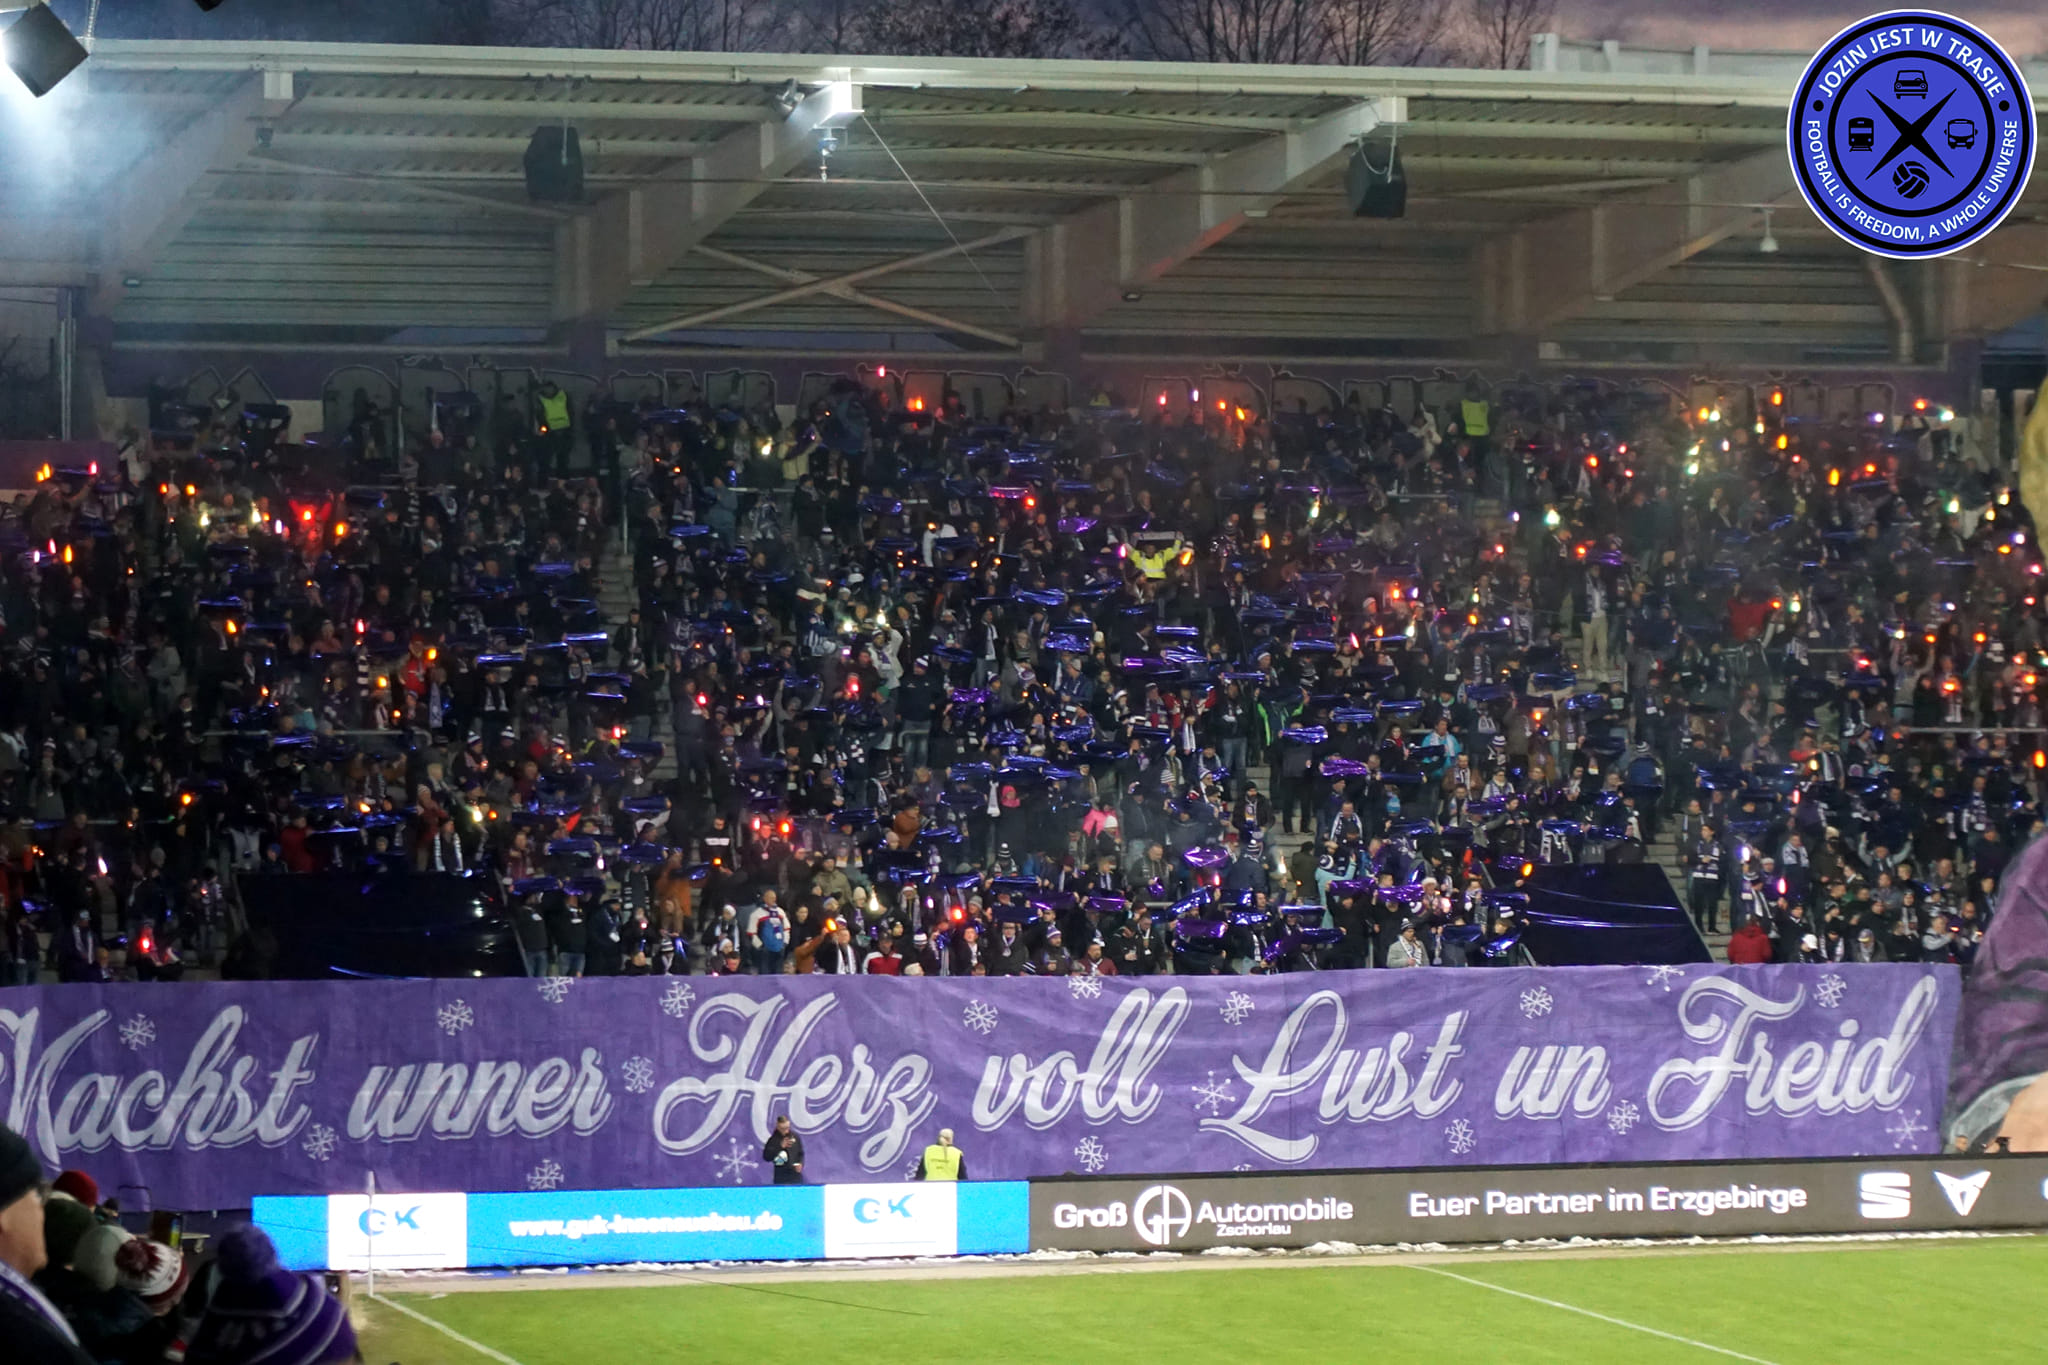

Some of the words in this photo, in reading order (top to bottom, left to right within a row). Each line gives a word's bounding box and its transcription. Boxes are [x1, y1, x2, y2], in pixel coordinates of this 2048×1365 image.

[347, 1047, 614, 1144] unner
[653, 992, 939, 1174] Herz
[971, 986, 1192, 1133] voll
[1199, 989, 1470, 1165] Lust
[1494, 1044, 1613, 1121] un
[1646, 974, 1940, 1133] Freid
[1054, 1201, 1128, 1228] Groß
[1196, 1197, 1354, 1221] Automobile
[1410, 1193, 1480, 1217] Euer
[1486, 1191, 1603, 1215] Partner
[1608, 1187, 1643, 1212] im
[1650, 1184, 1807, 1216] Erzgebirge
[1216, 1222, 1291, 1237] Zschorlau
